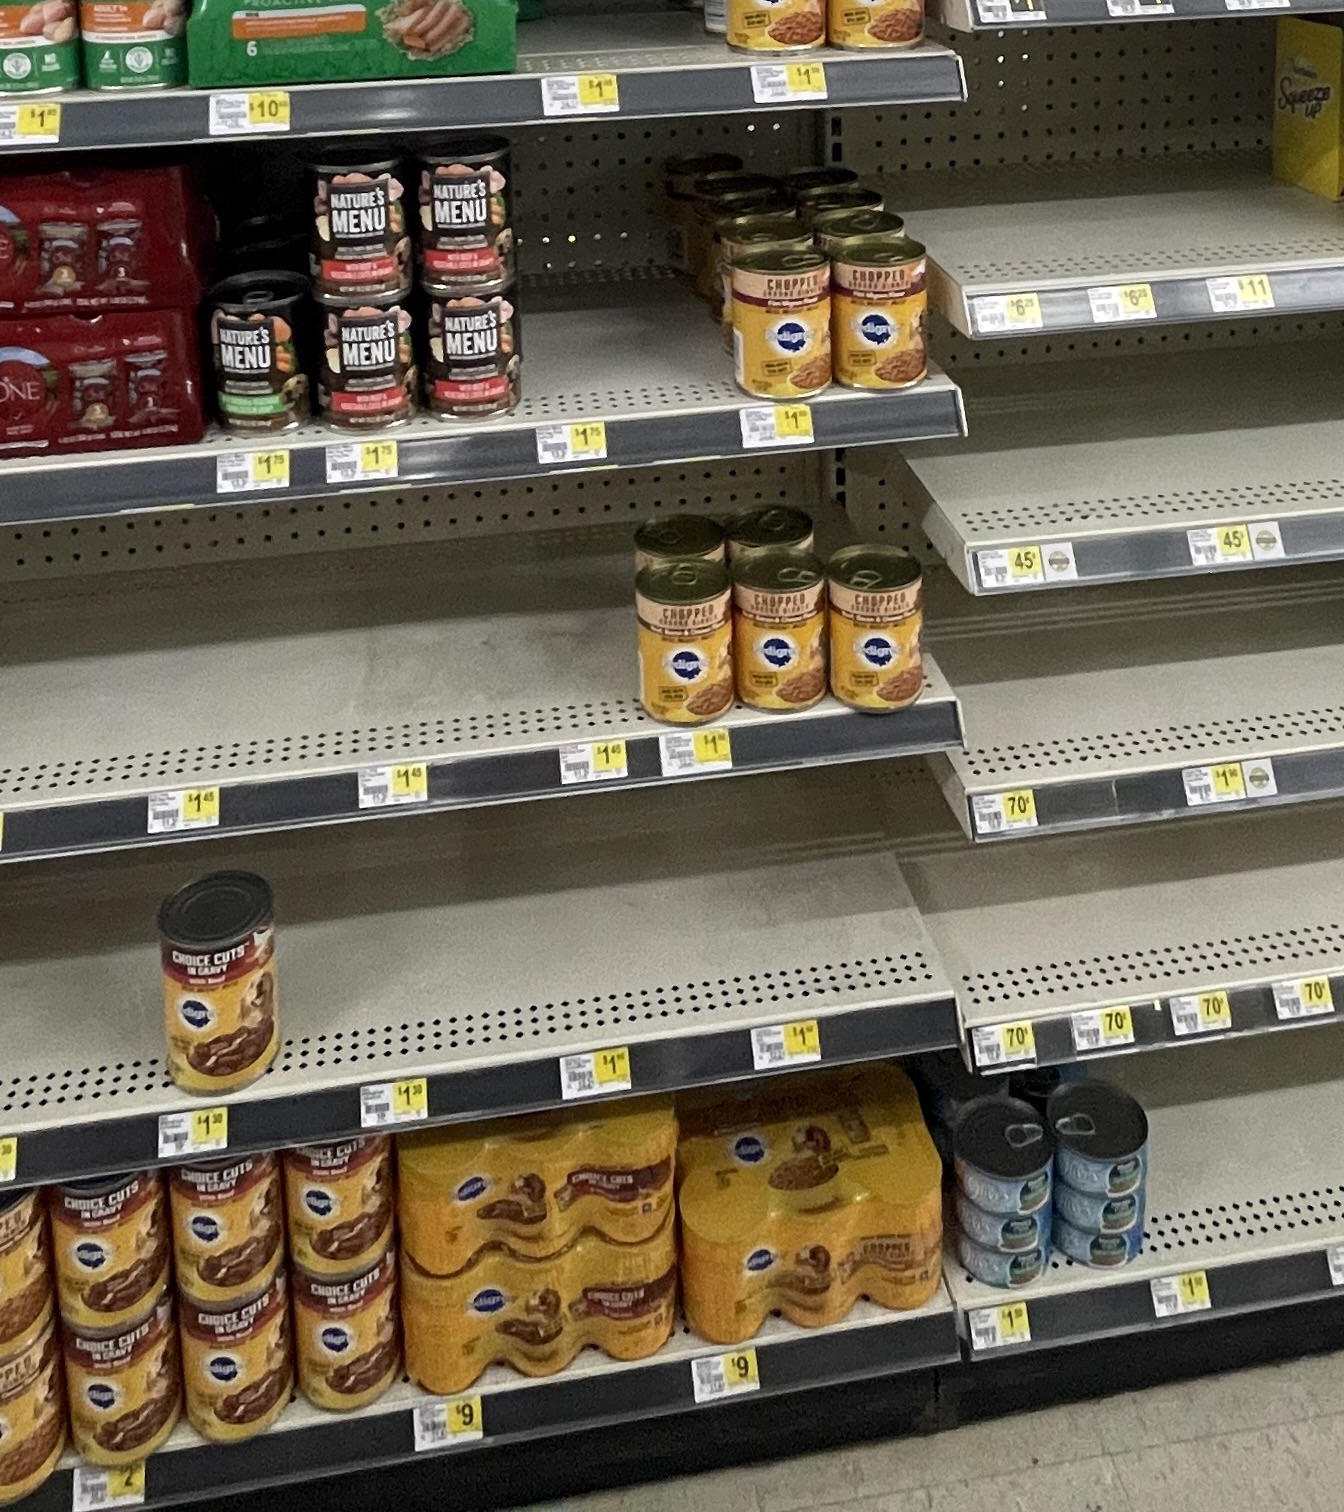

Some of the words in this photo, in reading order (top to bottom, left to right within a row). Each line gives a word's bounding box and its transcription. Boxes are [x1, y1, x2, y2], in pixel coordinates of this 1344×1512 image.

[331, 189, 384, 208] NATURE'S
[433, 179, 486, 199] NATURE'S
[332, 209, 385, 230] MENU
[434, 200, 487, 223] MENU
[342, 321, 394, 341] NATURE'S
[445, 311, 496, 331] NATURE'S
[343, 341, 394, 362] MENU
[447, 332, 497, 354] MENU
[220, 346, 270, 368] MENU
[172, 950, 211, 966] CHOICE
[188, 966, 199, 975] IN
[201, 963, 230, 975] GRAVY
[64, 1195, 102, 1212] CHOICE
[107, 1184, 139, 1205] CUTS
[311, 1283, 349, 1297] CHOICE
[353, 1271, 381, 1290] CUTS
[198, 1309, 236, 1326] CHOICE
[240, 1298, 271, 1319] CUTS
[76, 1334, 114, 1351] CHOICE
[118, 1323, 150, 1345] CUTS
